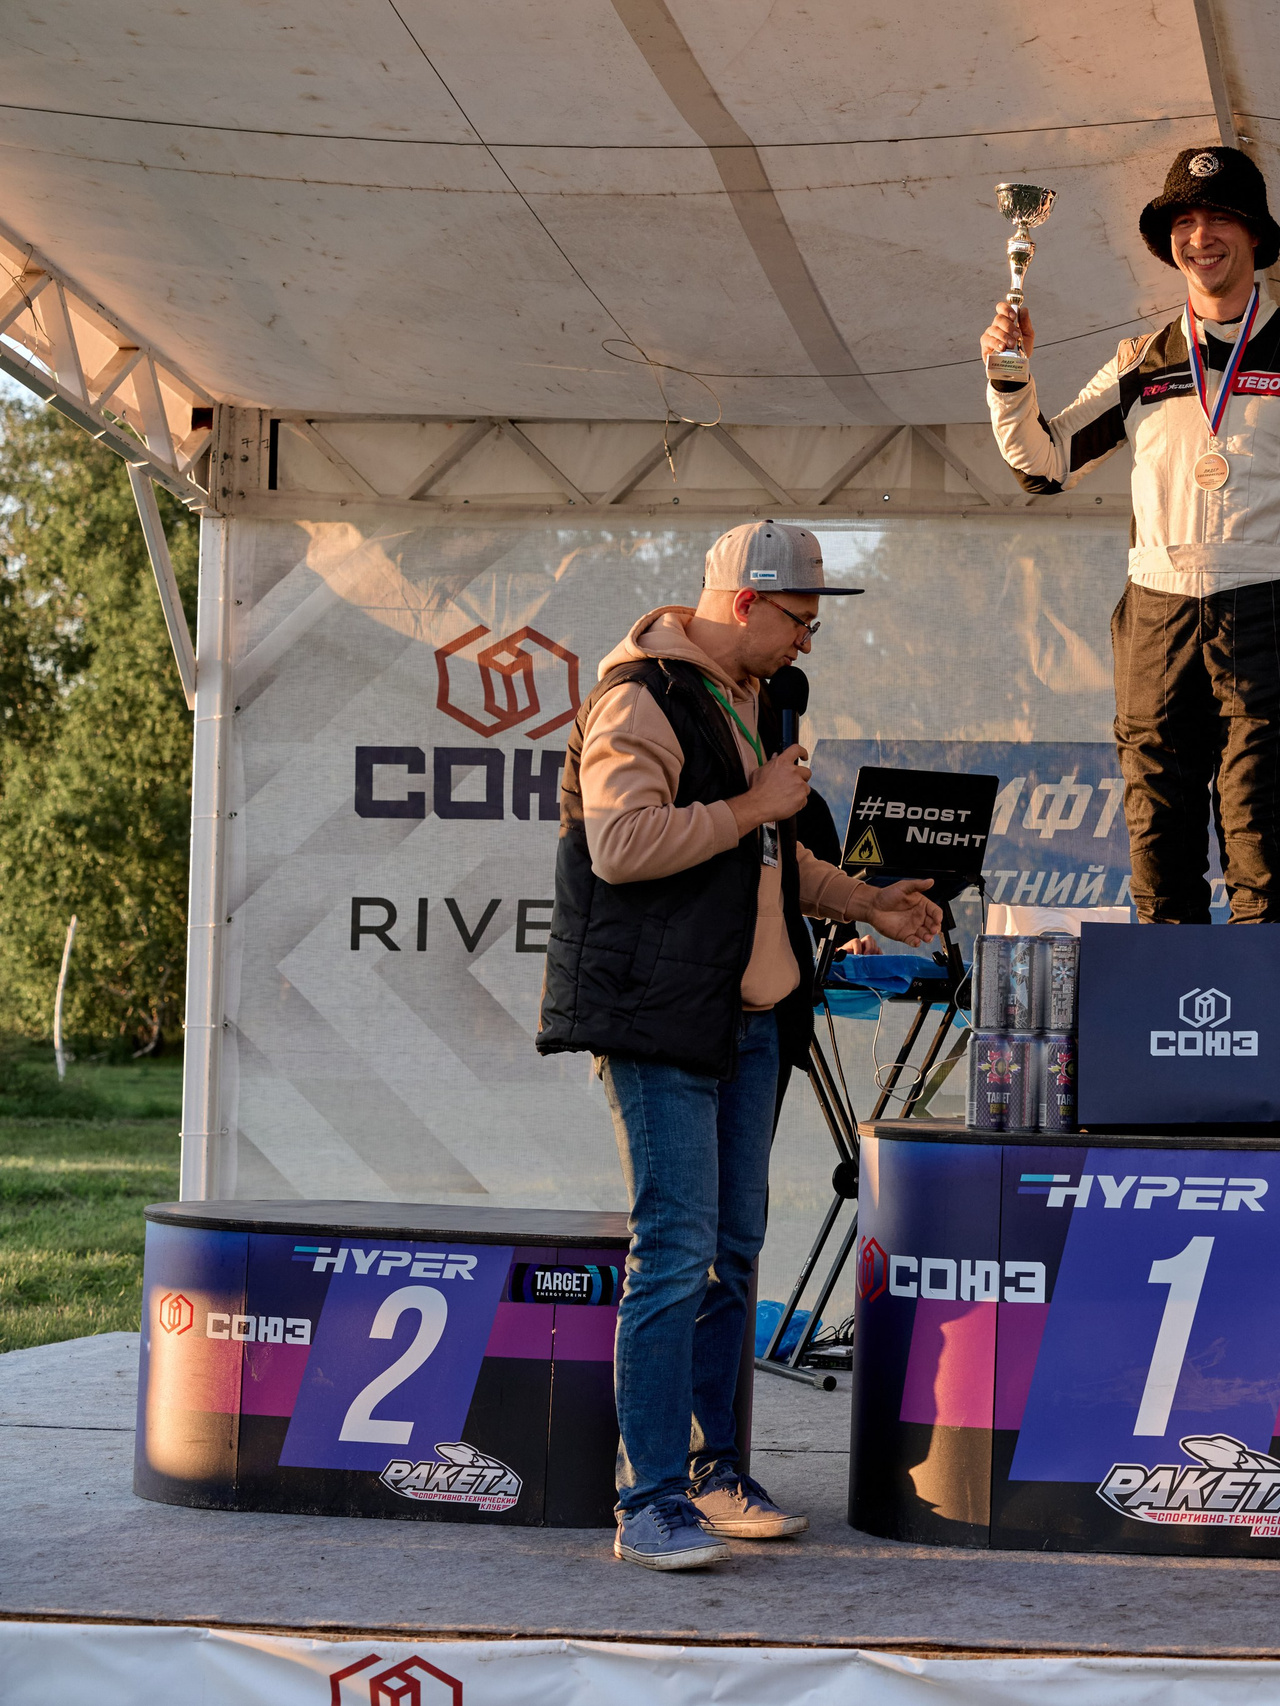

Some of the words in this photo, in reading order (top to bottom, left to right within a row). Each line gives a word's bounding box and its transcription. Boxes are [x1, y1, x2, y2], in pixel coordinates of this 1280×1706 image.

[354, 746, 562, 820] СОЮ
[990, 775, 1125, 839] ИФТ
[960, 865, 1107, 905] ЕТНИЙ
[350, 896, 552, 954] RIVE
[1150, 1030, 1258, 1056] СОЮЗ
[1046, 1174, 1269, 1212] HYPER
[312, 1248, 478, 1281] HYPER
[535, 1271, 590, 1291] TARGET
[889, 1255, 1046, 1303] СОЮЗ
[206, 1312, 312, 1345] СОЮЗ
[1133, 1236, 1216, 1437] 1
[338, 1285, 449, 1445] 2
[382, 1462, 519, 1495] РАКЕТА
[417, 1492, 517, 1505] СПОРТИВНО-ТЕХНИЧЕСКИЙ
[480, 1503, 502, 1511] КЛУБ
